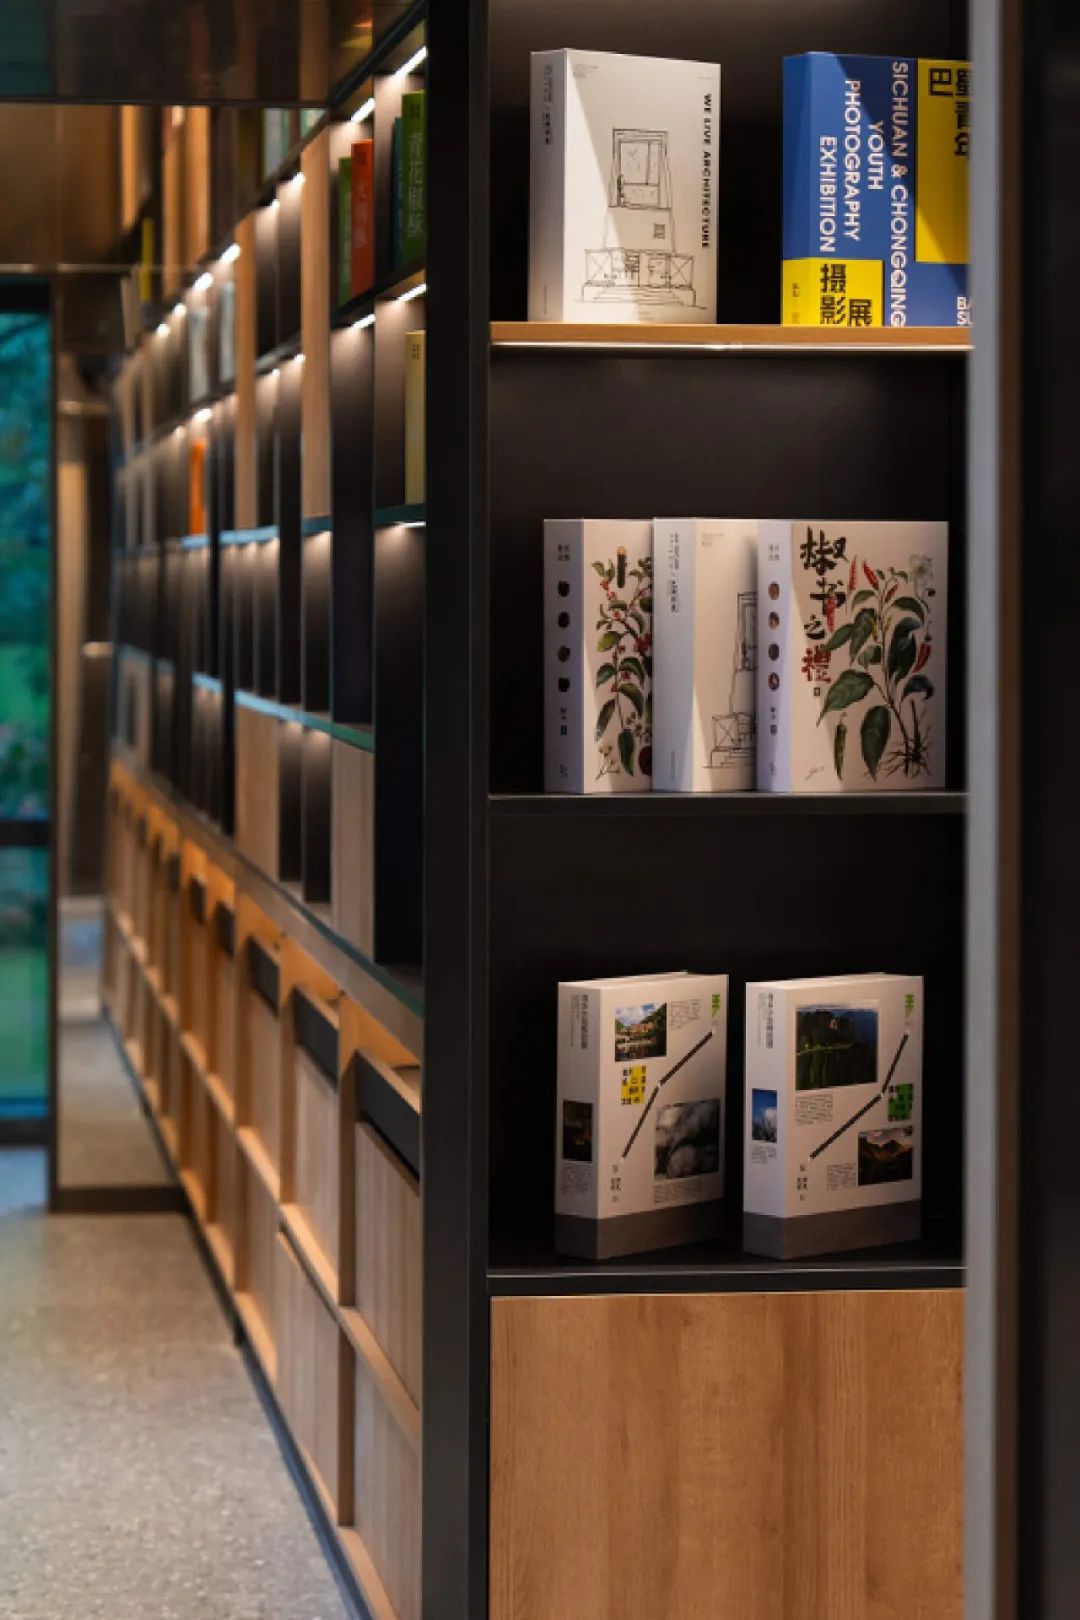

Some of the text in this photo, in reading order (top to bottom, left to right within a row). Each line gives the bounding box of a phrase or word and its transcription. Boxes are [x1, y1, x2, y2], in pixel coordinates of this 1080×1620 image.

[701, 93, 712, 248] WE LIVE ARCHITECTURE
[820, 136, 837, 252] EXHIBITION
[844, 80, 860, 240] PHOTOGRAPHY
[868, 120, 883, 190] YOUTH
[890, 62, 908, 326] SICHUAN & CHONGQING
[820, 263, 846, 325] 摄影
[848, 299, 872, 327] 展
